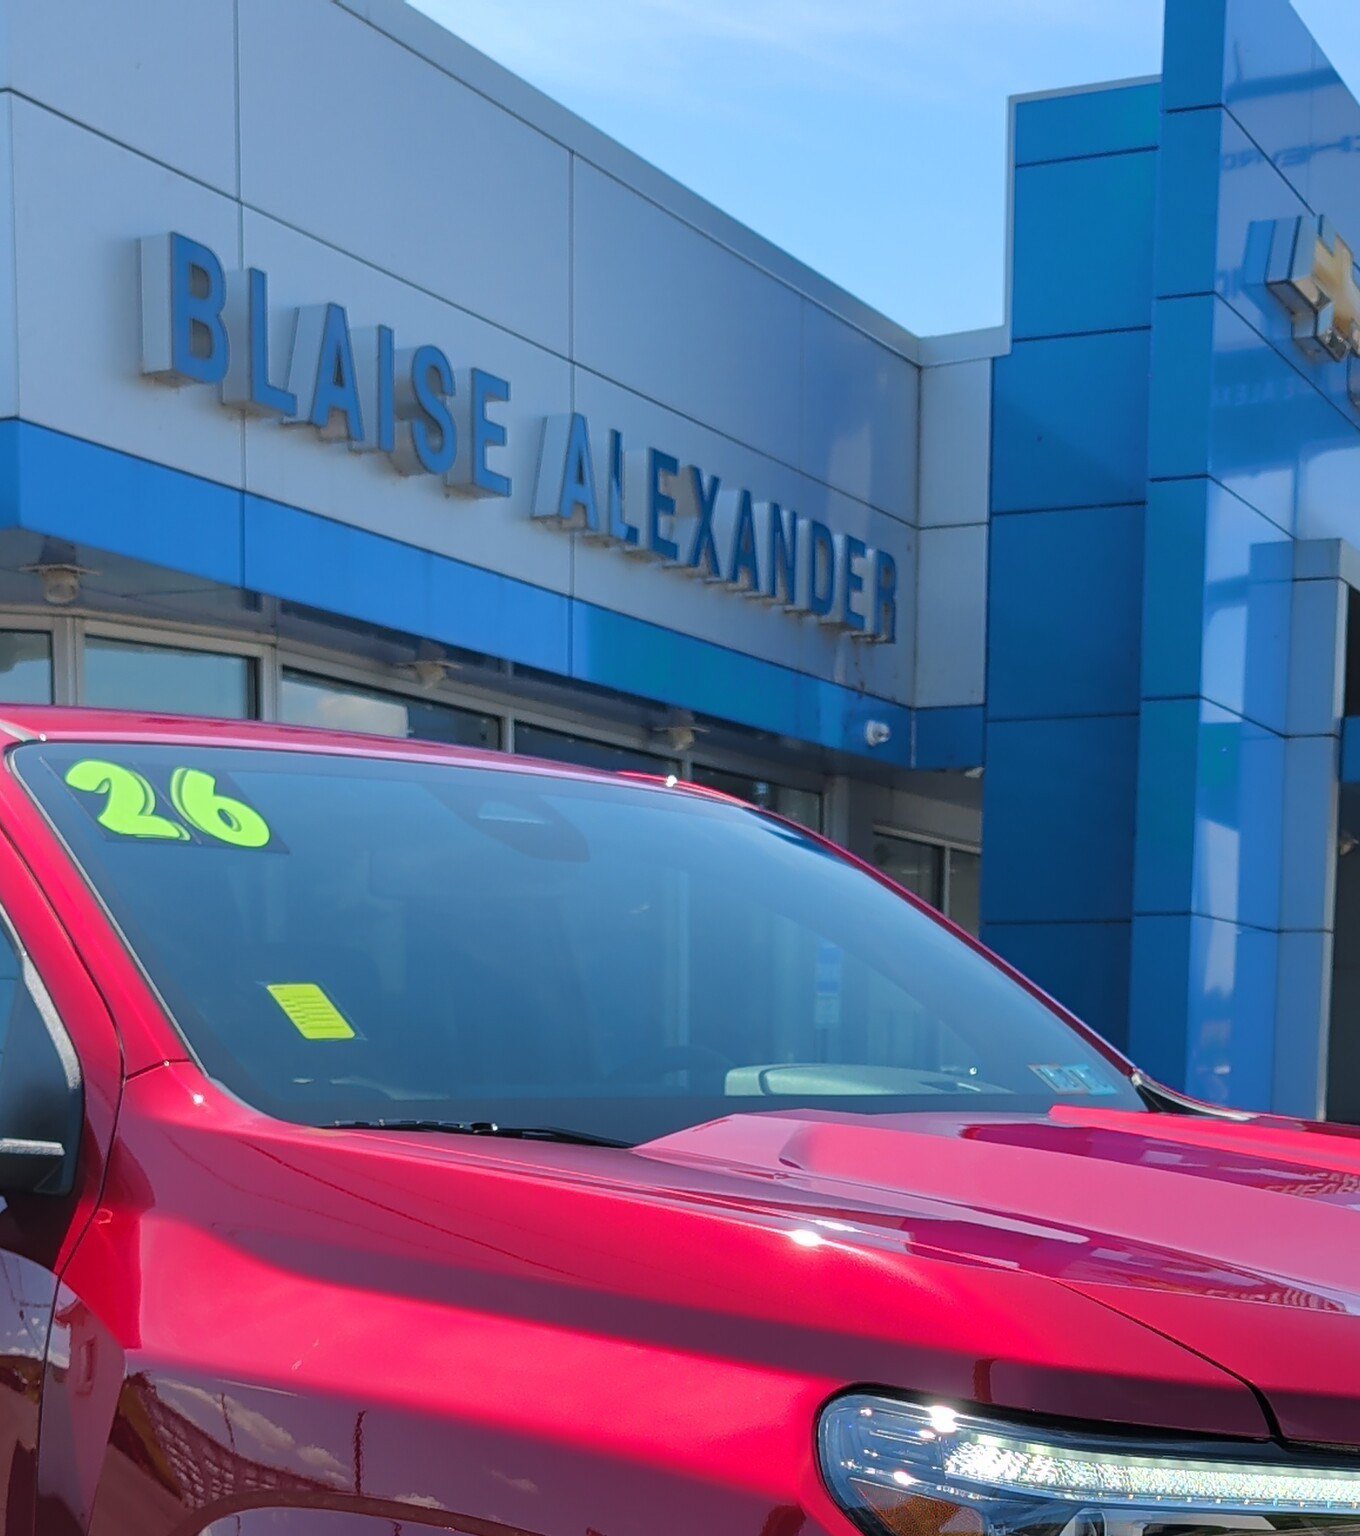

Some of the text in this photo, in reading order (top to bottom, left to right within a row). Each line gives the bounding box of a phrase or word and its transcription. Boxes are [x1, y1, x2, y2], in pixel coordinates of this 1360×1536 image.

[140, 230, 899, 645] BLAISE ALEXANDER
[64, 758, 271, 848] 26
